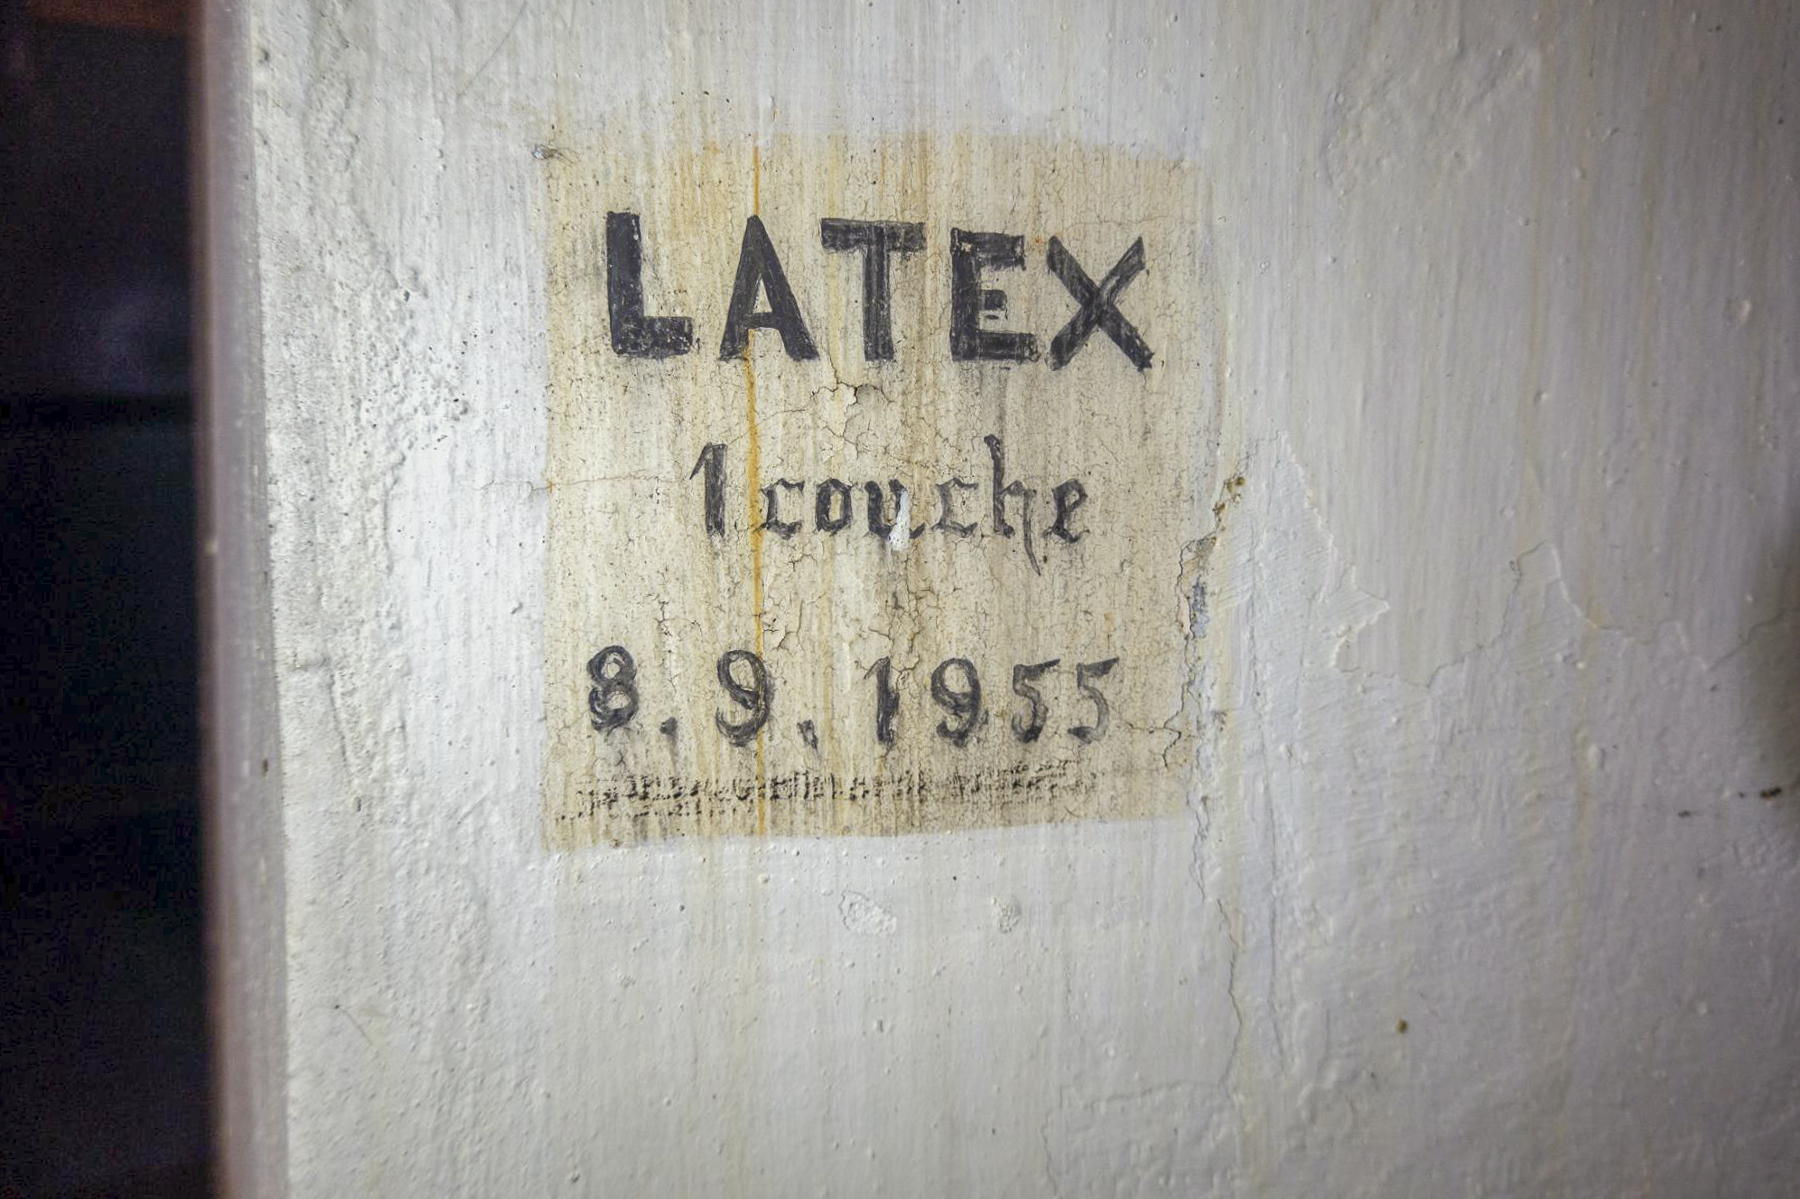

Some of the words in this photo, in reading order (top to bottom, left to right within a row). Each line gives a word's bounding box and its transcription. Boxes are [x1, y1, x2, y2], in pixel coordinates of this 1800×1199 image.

[606, 211, 1154, 371] LATEX
[689, 442, 727, 537] 1
[760, 434, 1089, 576] couche
